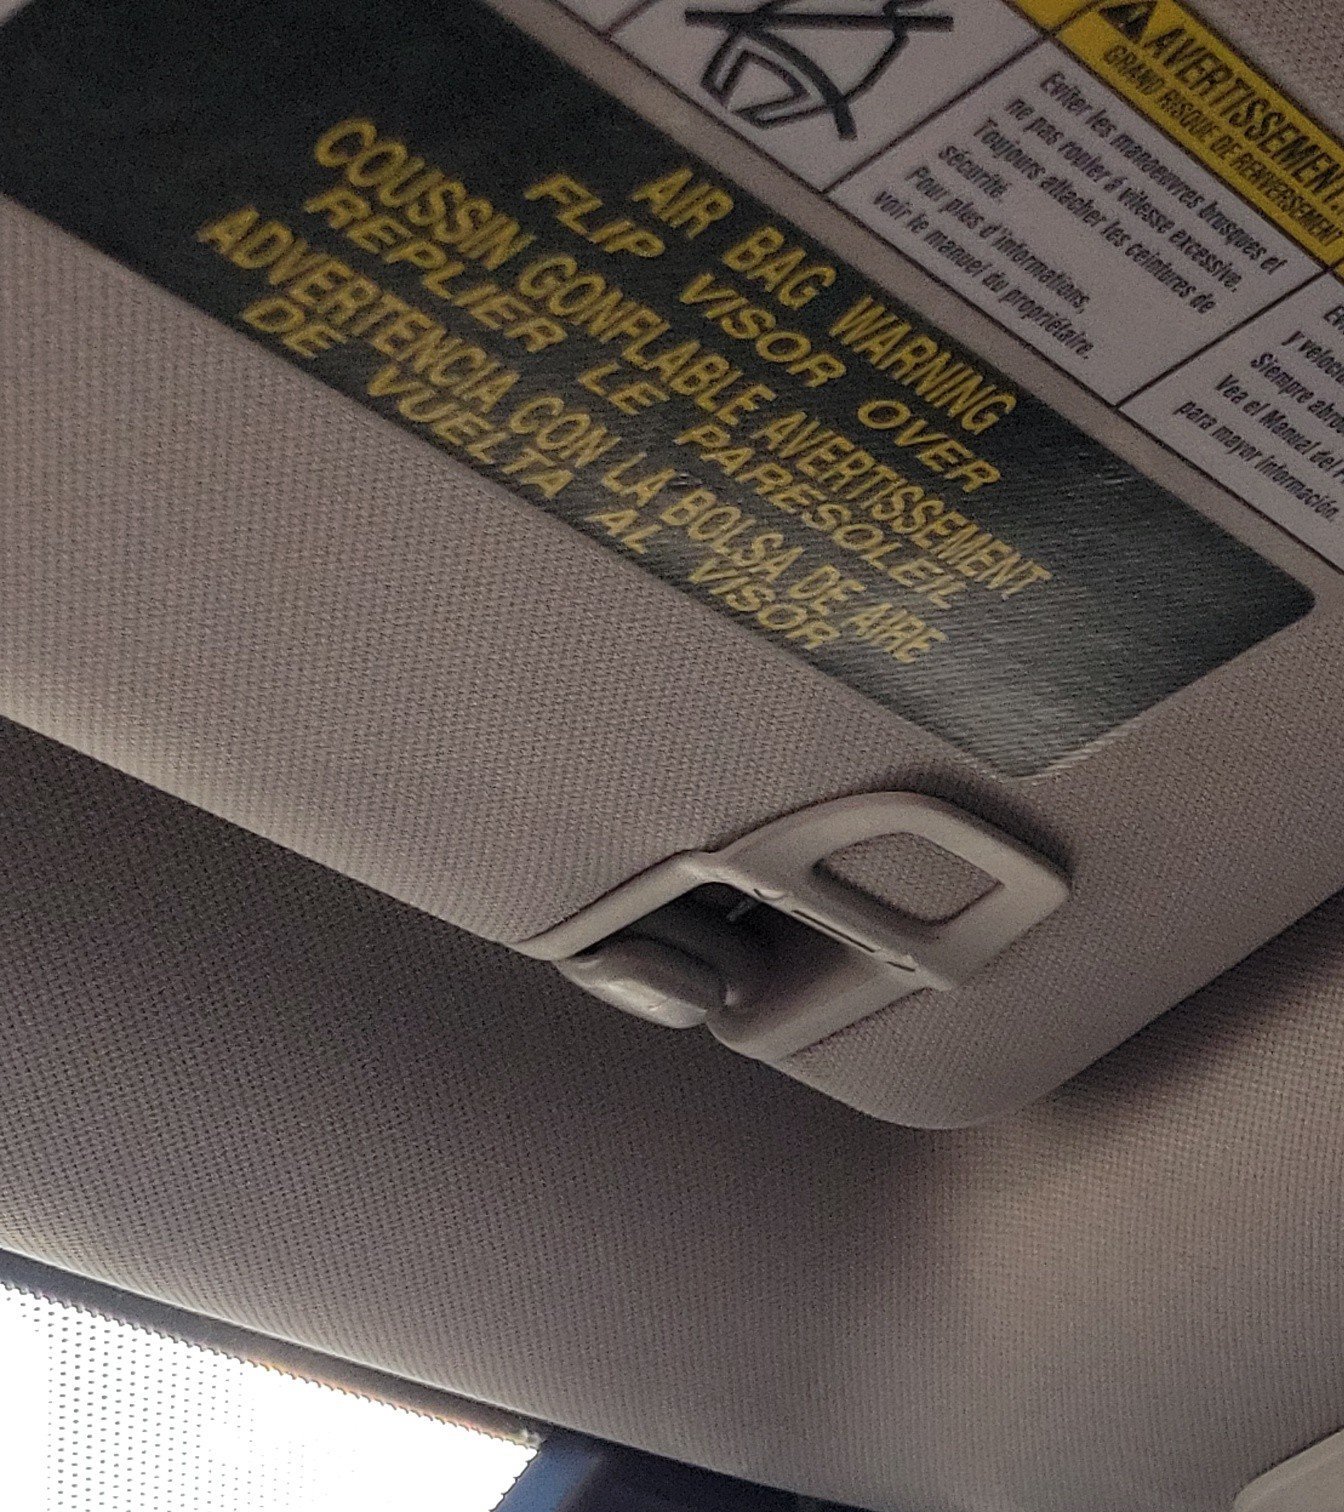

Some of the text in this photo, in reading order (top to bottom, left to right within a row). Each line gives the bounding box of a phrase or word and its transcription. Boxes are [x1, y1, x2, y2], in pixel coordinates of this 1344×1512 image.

[905, 165, 950, 202] Pour
[937, 197, 986, 230] plus
[1005, 97, 1035, 121] ne
[1022, 115, 1065, 146] pas
[1057, 140, 1112, 183] rouler
[1117, 186, 1175, 234] vitesse
[1168, 228, 1243, 294] excessive.
[1039, 70, 1288, 275] Eviter les manoeuvres brusques et
[1103, 44, 1166, 96] GRAND
[1156, 88, 1221, 143] RISQUE
[1208, 133, 1243, 161] DE
[632, 168, 1016, 434] AIR BAG WARNING
[872, 190, 913, 220] voir
[905, 212, 930, 234] le
[923, 229, 993, 277] manuel
[981, 272, 1010, 293] du
[973, 116, 1216, 314] Toujours attacher les ceintures de
[305, 187, 966, 609] REPLIER LE PARESOLEIL
[315, 121, 1051, 598] COUSSIN GONFLABLE AVERTISSEMENT
[524, 173, 1001, 493] FLIP VISOR OVER
[1172, 400, 1218, 431] para
[1210, 424, 1264, 462] mayor
[1215, 373, 1249, 405] Vea
[1242, 399, 1271, 417] el
[1258, 408, 1322, 455] Manual
[1308, 450, 1344, 472] del
[1249, 352, 1315, 404] Siempre
[1280, 326, 1306, 349] y
[202, 209, 946, 663] ADVERTENCIA CON LA BOLSA DE AIRE
[243, 297, 841, 650] DE VUELTA AL VISOR
